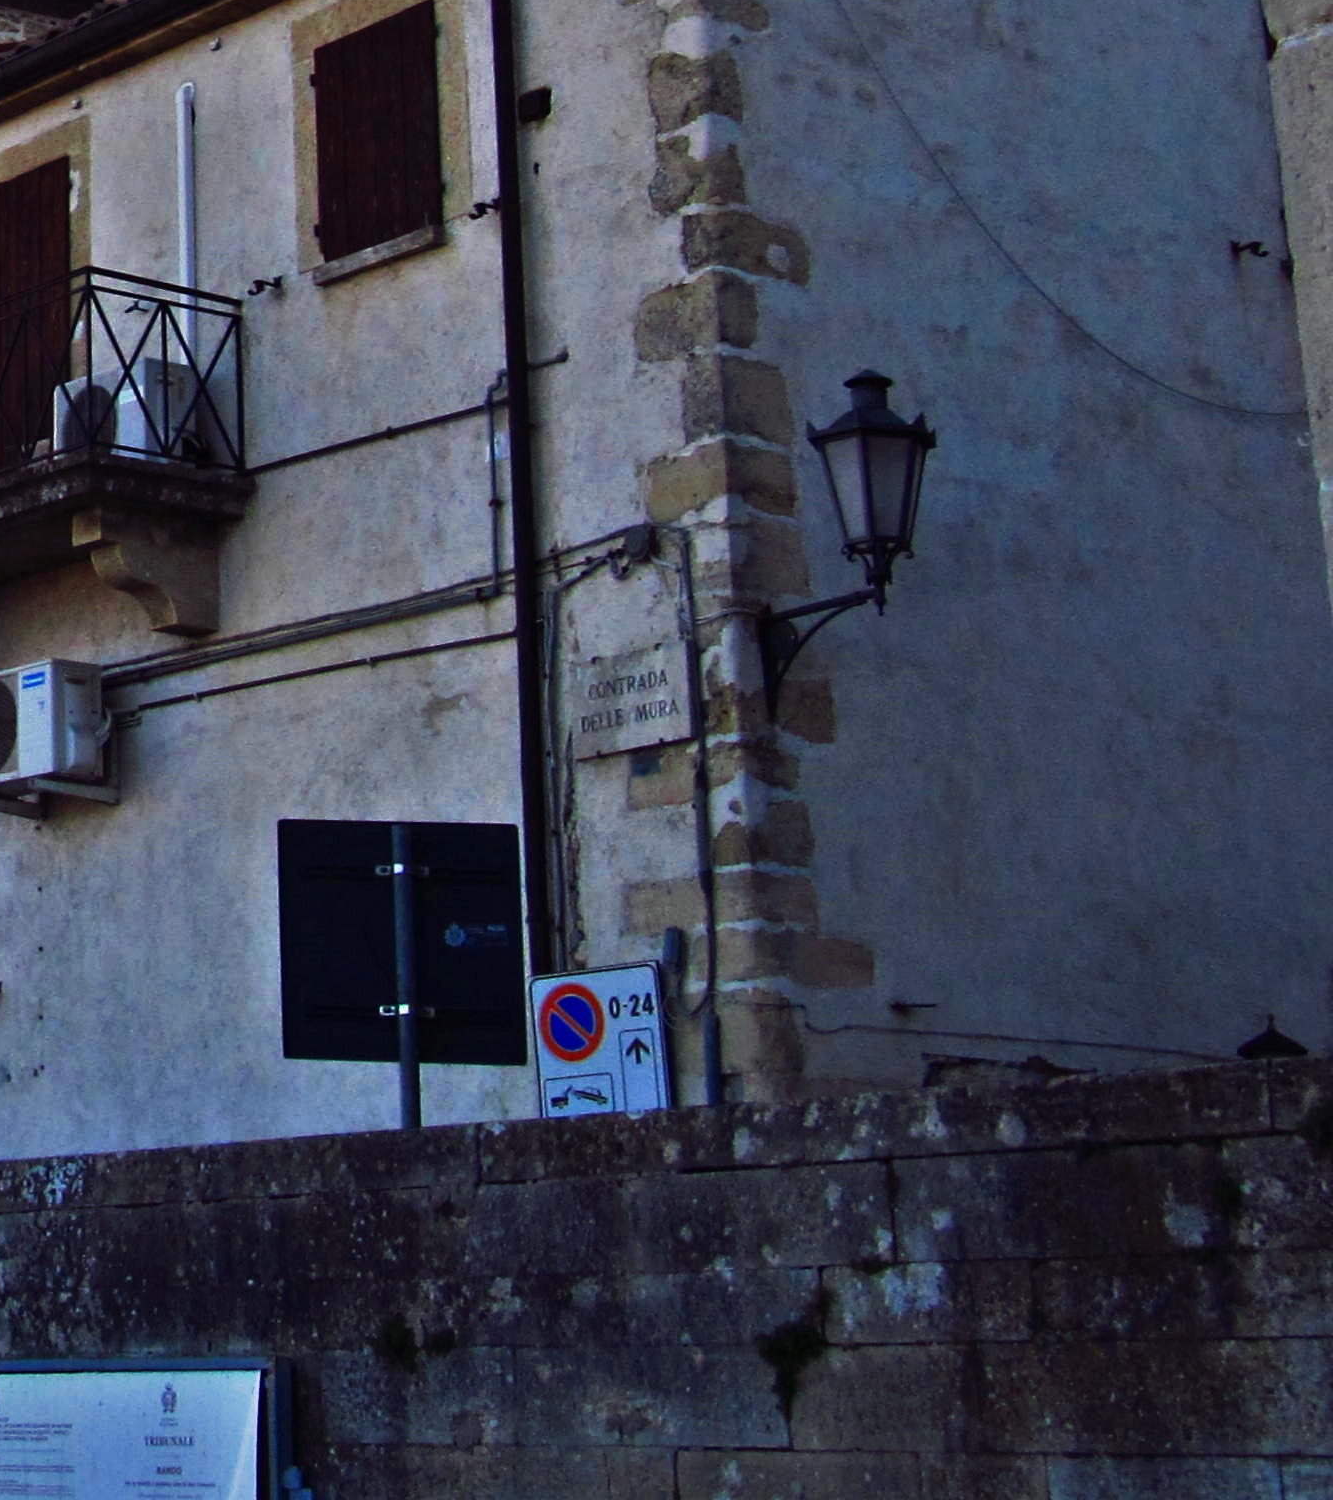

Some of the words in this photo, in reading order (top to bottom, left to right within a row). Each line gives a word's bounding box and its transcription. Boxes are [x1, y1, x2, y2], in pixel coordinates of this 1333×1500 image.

[588, 668, 669, 701] CONTRADA
[580, 708, 624, 734] DELLE
[634, 699, 680, 723] MURA
[608, 992, 655, 1019] 0-24
[144, 1435, 195, 1447] TRIBUNALE
